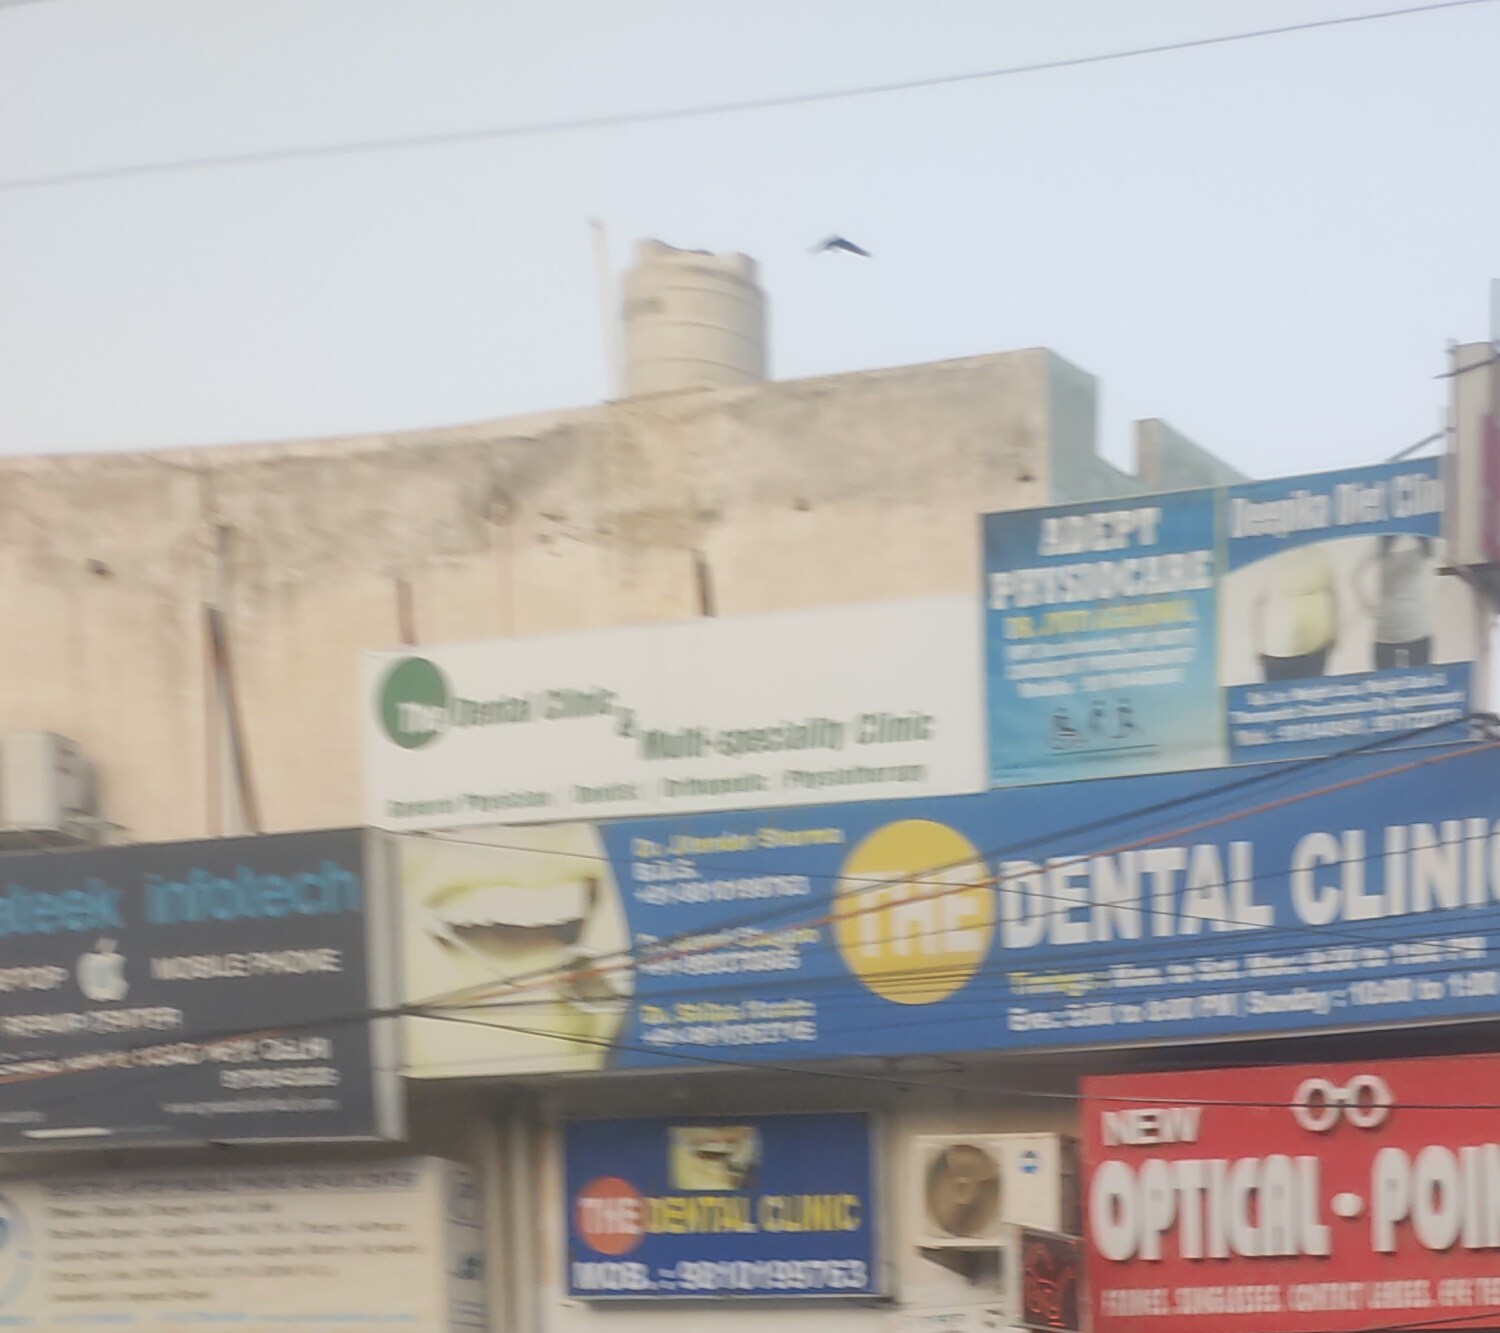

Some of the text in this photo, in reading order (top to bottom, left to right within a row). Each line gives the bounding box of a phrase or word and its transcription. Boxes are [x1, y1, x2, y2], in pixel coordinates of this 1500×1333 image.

[998, 840, 1276, 950] DENTAL
[1101, 1108, 1200, 1147] NEW
[758, 1194, 862, 1233] CLINIC
[1089, 1154, 1332, 1263] OPTICAL
